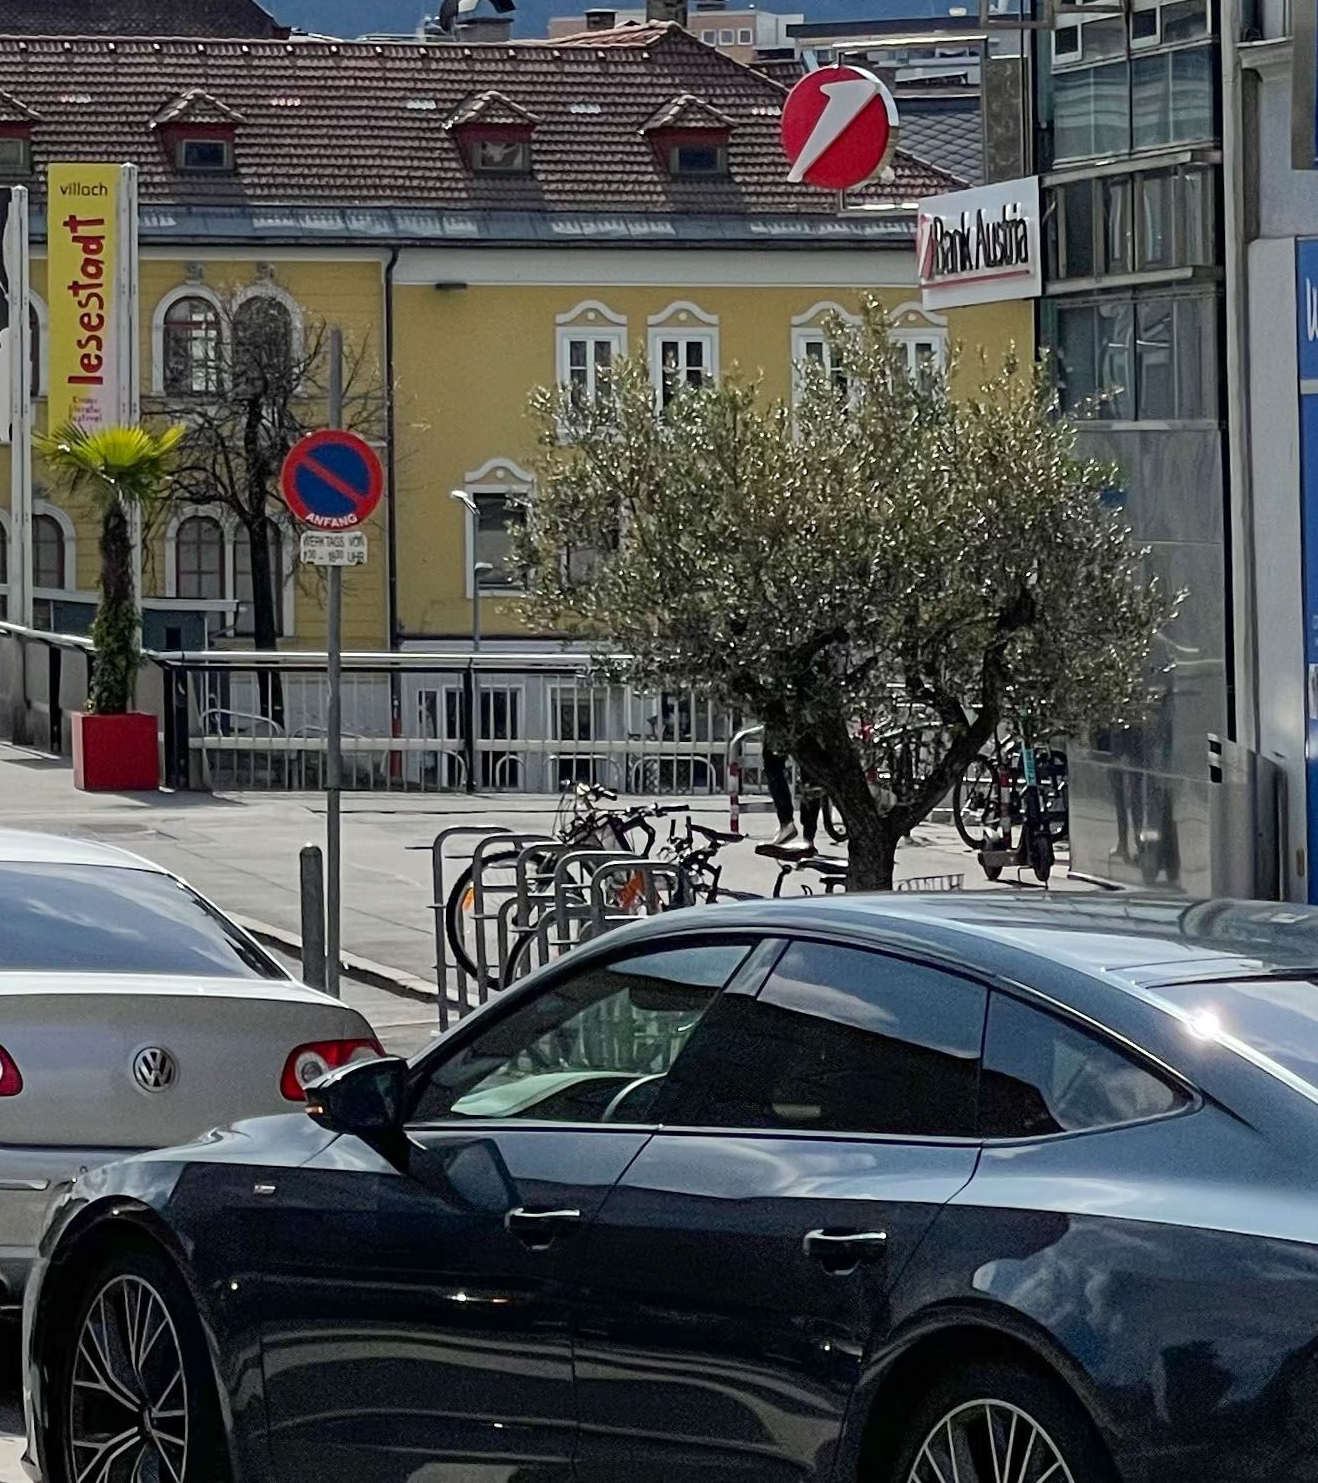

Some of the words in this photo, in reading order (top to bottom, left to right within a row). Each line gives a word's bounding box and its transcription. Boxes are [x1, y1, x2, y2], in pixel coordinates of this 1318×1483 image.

[60, 181, 108, 197] villach
[934, 212, 974, 277] Bank
[975, 203, 1029, 270] Austria
[63, 214, 106, 386] lesestadt
[306, 513, 358, 528] ANFANG
